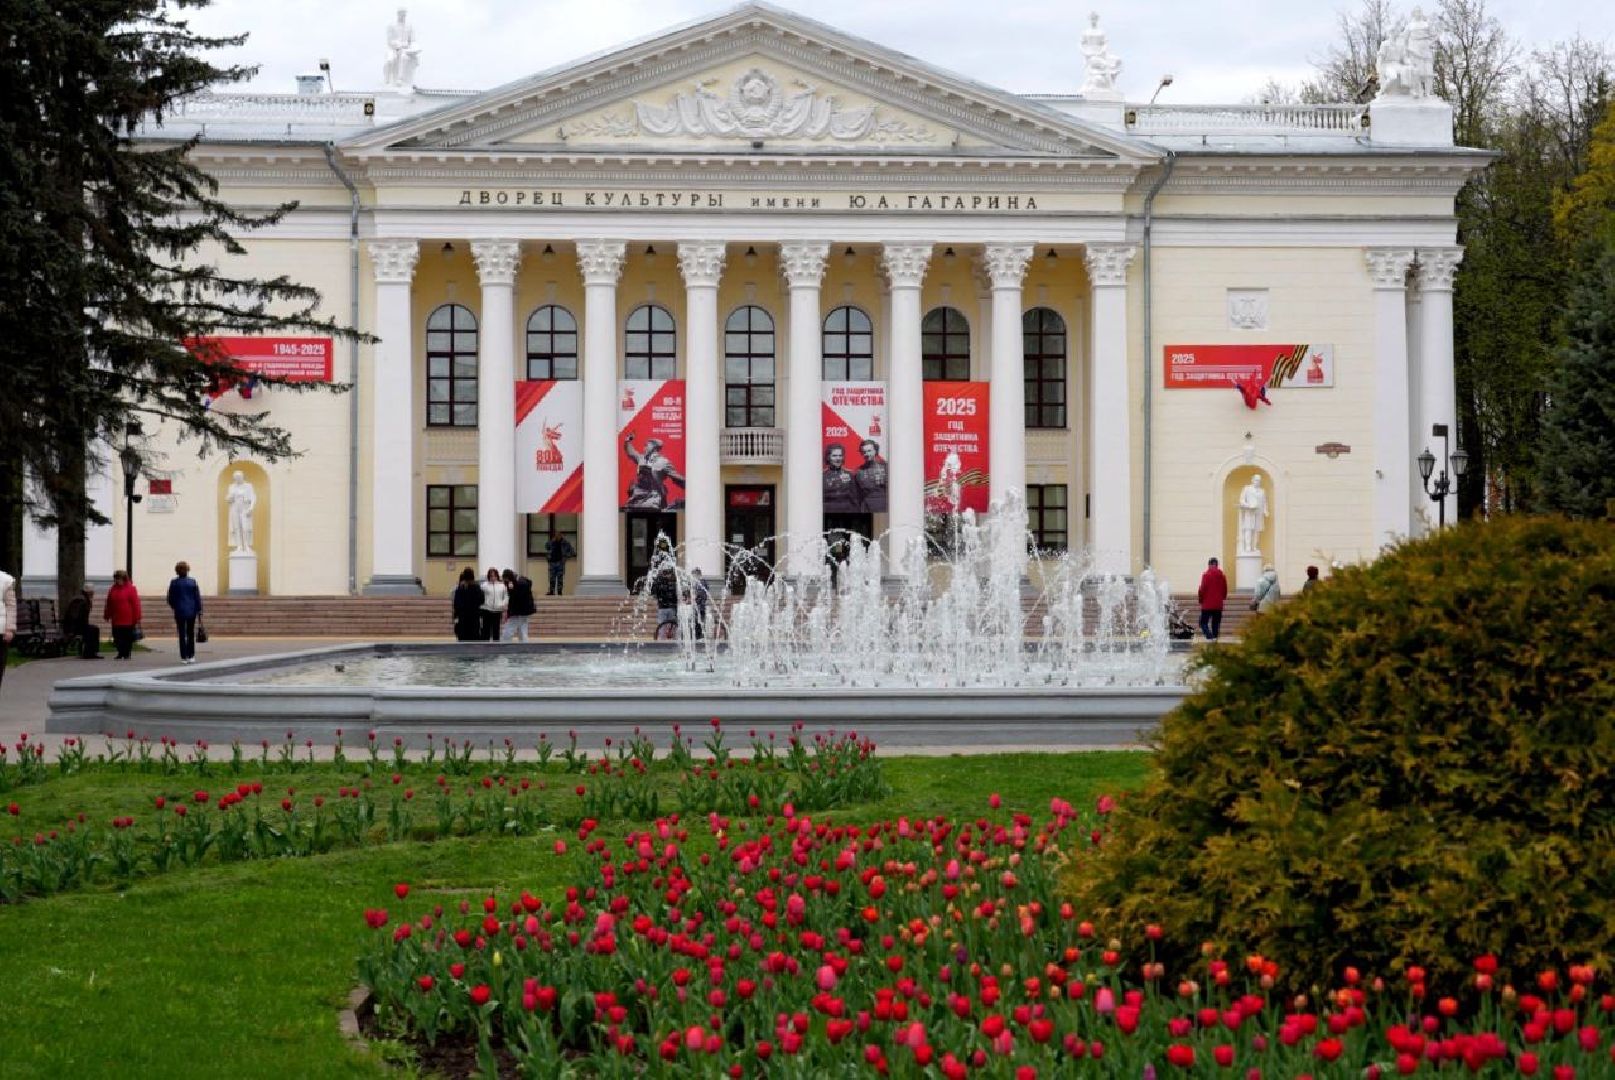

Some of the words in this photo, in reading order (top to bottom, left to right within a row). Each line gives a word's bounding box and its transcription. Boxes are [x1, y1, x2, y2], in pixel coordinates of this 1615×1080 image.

[459, 190, 563, 207] ДВОРЕЦ
[585, 191, 723, 208] КУЛЬТУРЫ
[272, 343, 325, 355] 1945-2025
[1172, 353, 1195, 364] 2025
[832, 396, 884, 406] ОТЕЧЕСТВА
[936, 397, 976, 416] 2025
[947, 420, 964, 431] ГОД
[826, 426, 848, 437] 2025
